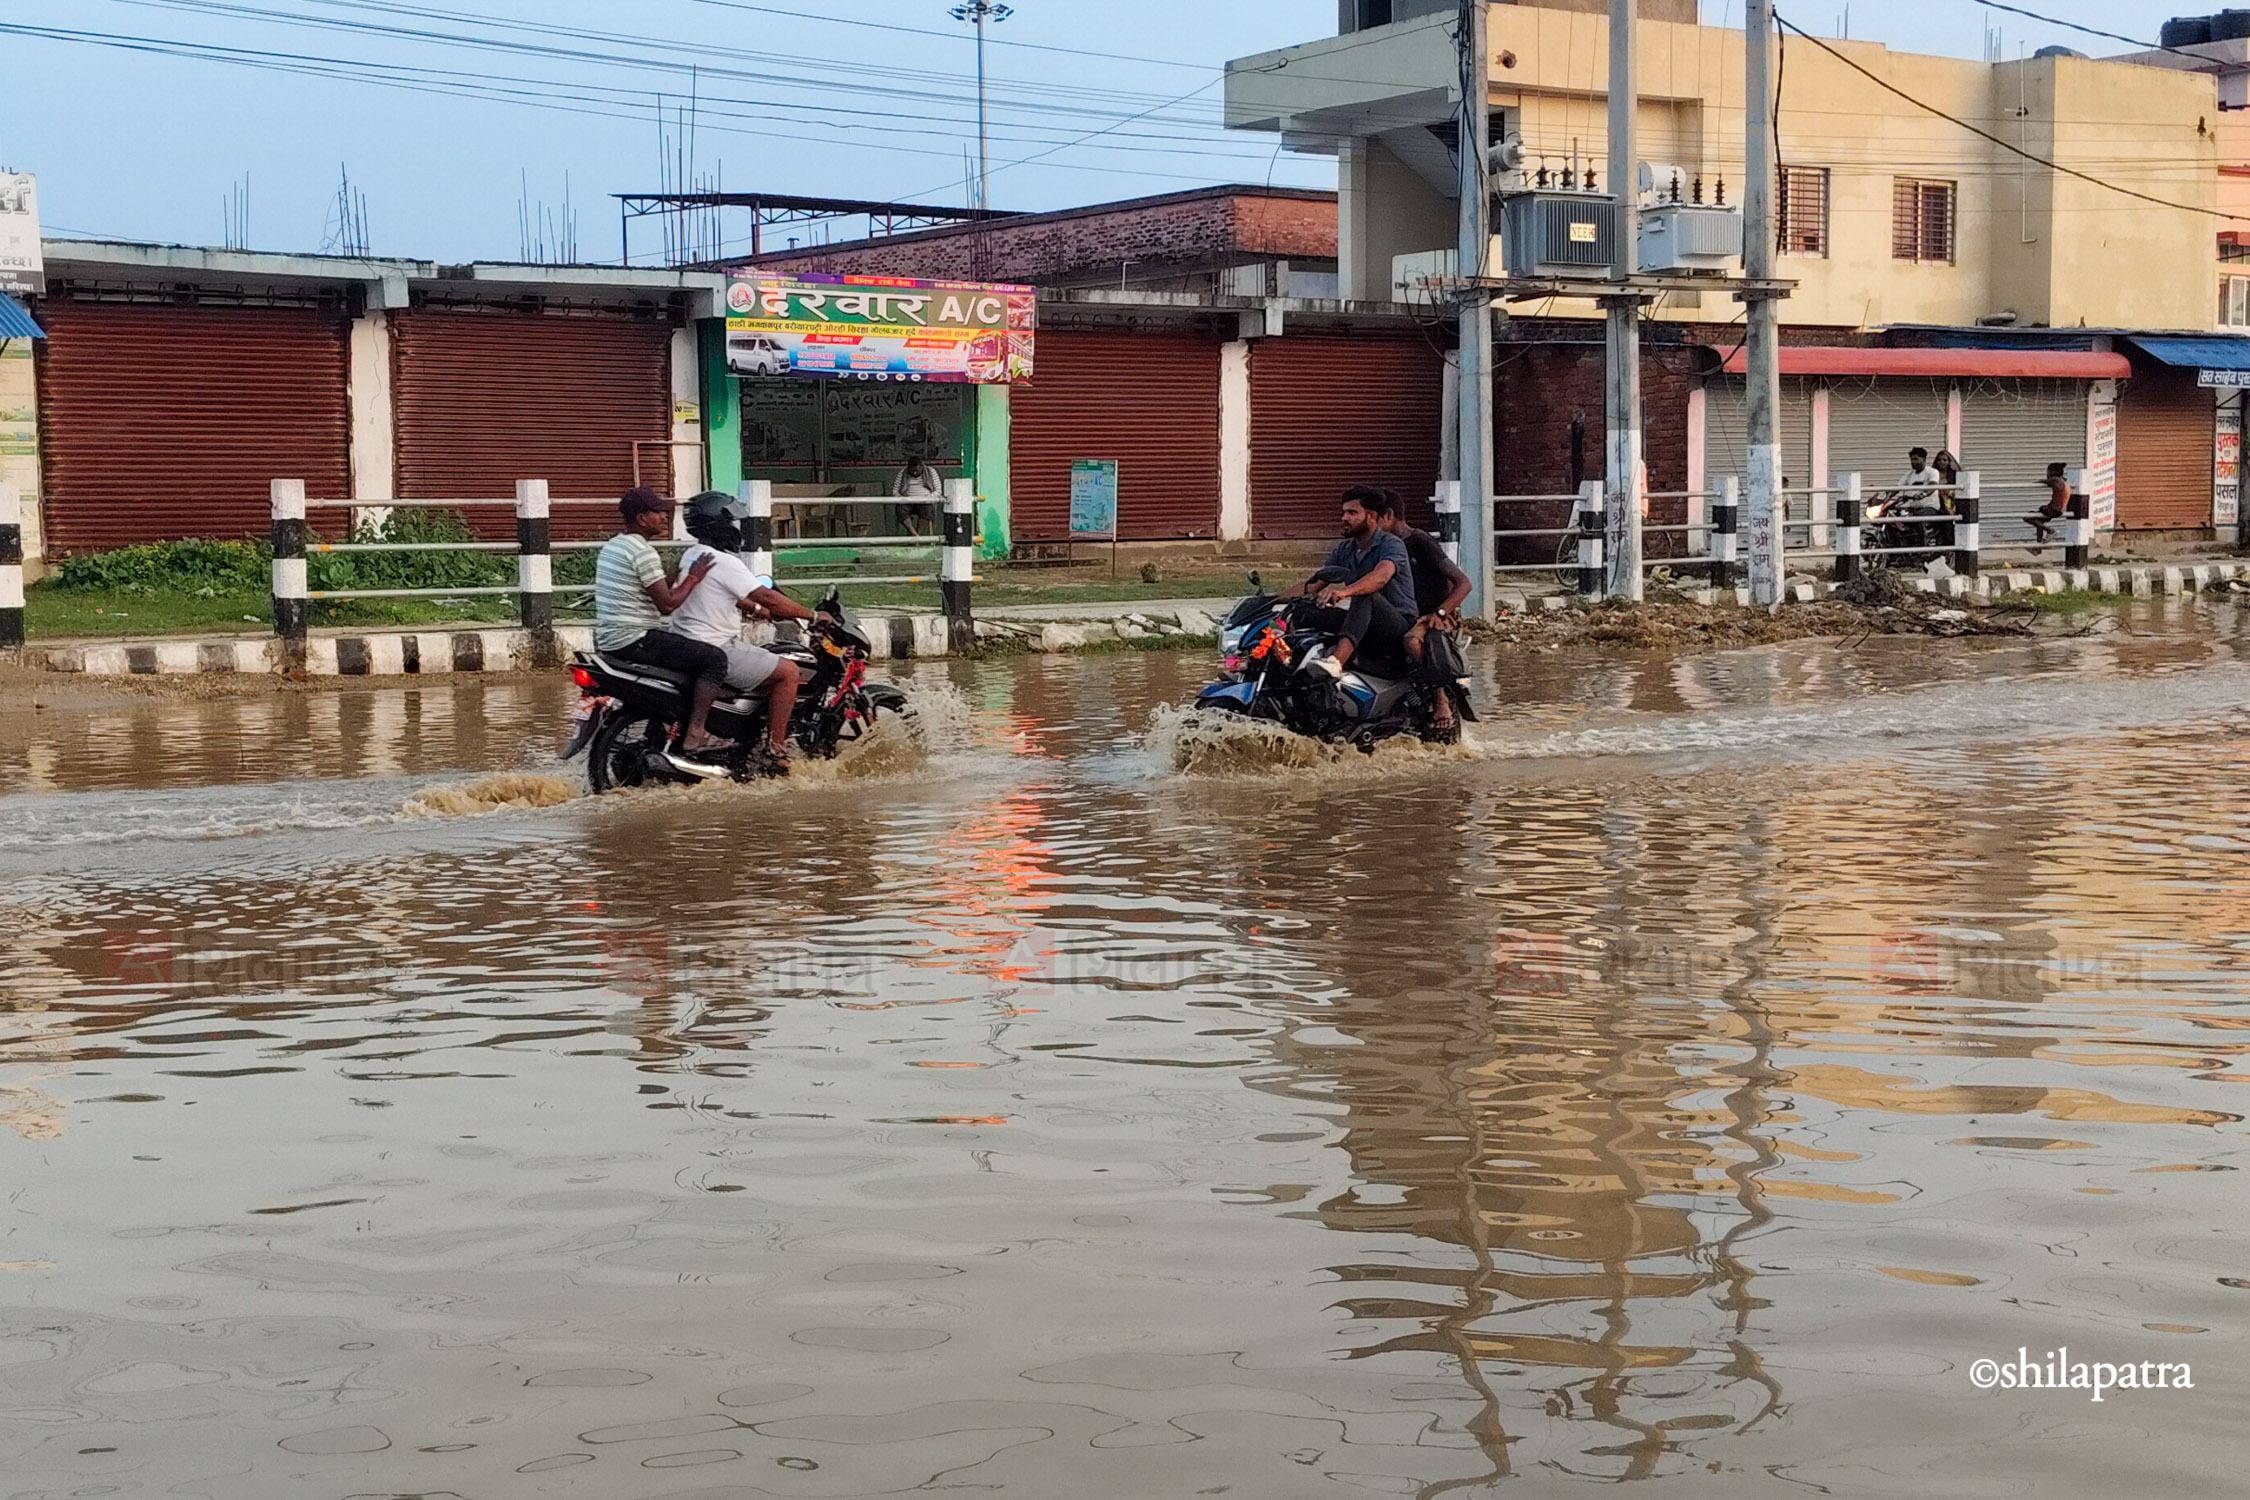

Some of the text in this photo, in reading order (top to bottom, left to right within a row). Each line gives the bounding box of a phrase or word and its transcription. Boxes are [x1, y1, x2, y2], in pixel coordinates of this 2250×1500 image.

[938, 296, 1002, 326] A/C
[2216, 484, 2238, 499] पसल
[1752, 517, 1770, 528] जय
[1754, 531, 1769, 549] श्री
